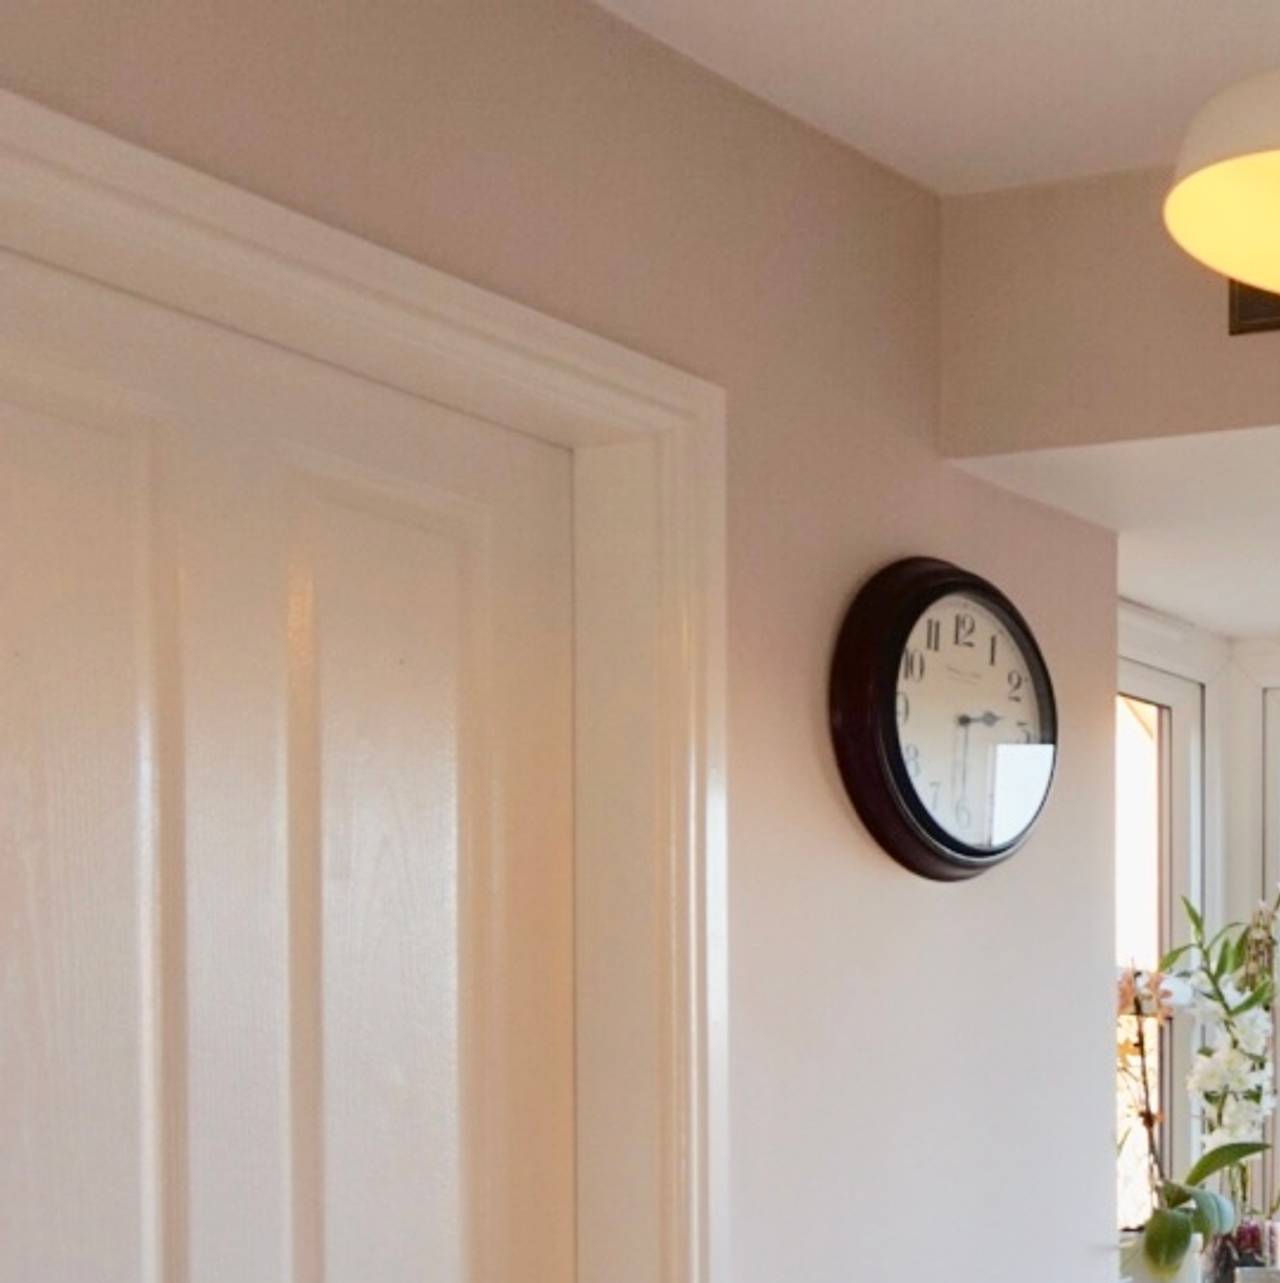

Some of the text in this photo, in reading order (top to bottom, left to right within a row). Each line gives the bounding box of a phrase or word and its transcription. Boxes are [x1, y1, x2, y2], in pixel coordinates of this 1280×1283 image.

[926, 618, 941, 652] 11
[953, 613, 976, 648] 12
[903, 648, 926, 682] 10
[988, 634, 997, 667] 1
[1007, 669, 1022, 702] 2
